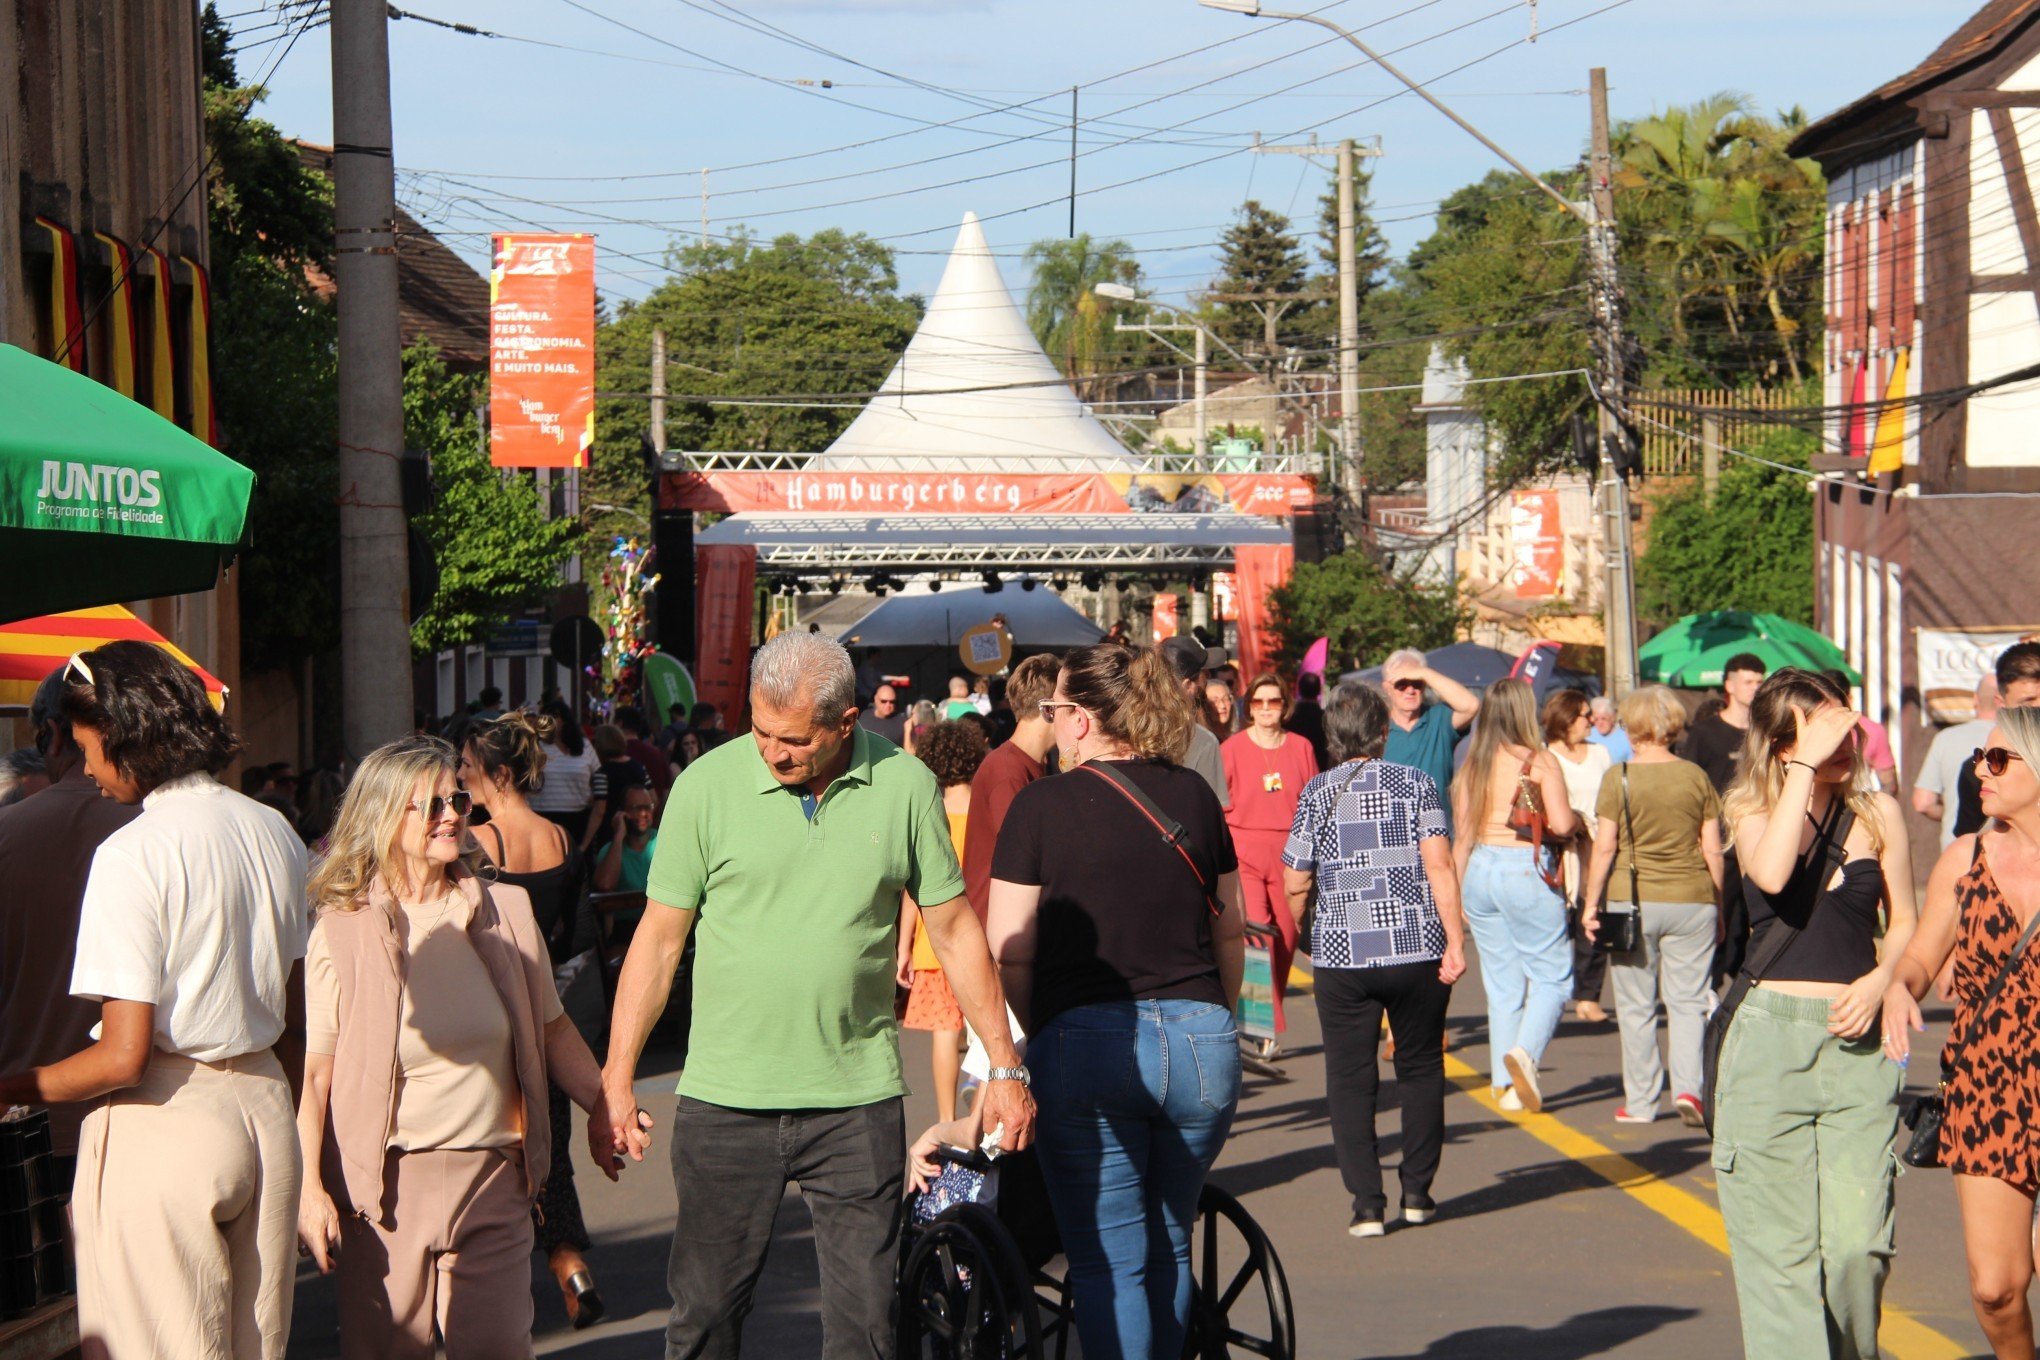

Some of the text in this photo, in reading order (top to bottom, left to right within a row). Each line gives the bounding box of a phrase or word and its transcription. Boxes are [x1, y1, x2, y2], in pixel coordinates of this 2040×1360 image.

[494, 324, 535, 334] FESTA.
[494, 337, 585, 348] GASTRONOMIA.
[494, 350, 529, 360] ARTE.
[494, 363, 579, 374] E MUITO MAIS.
[37, 460, 161, 507] JUNTOS
[37, 501, 163, 524] Programa de Fidelidade
